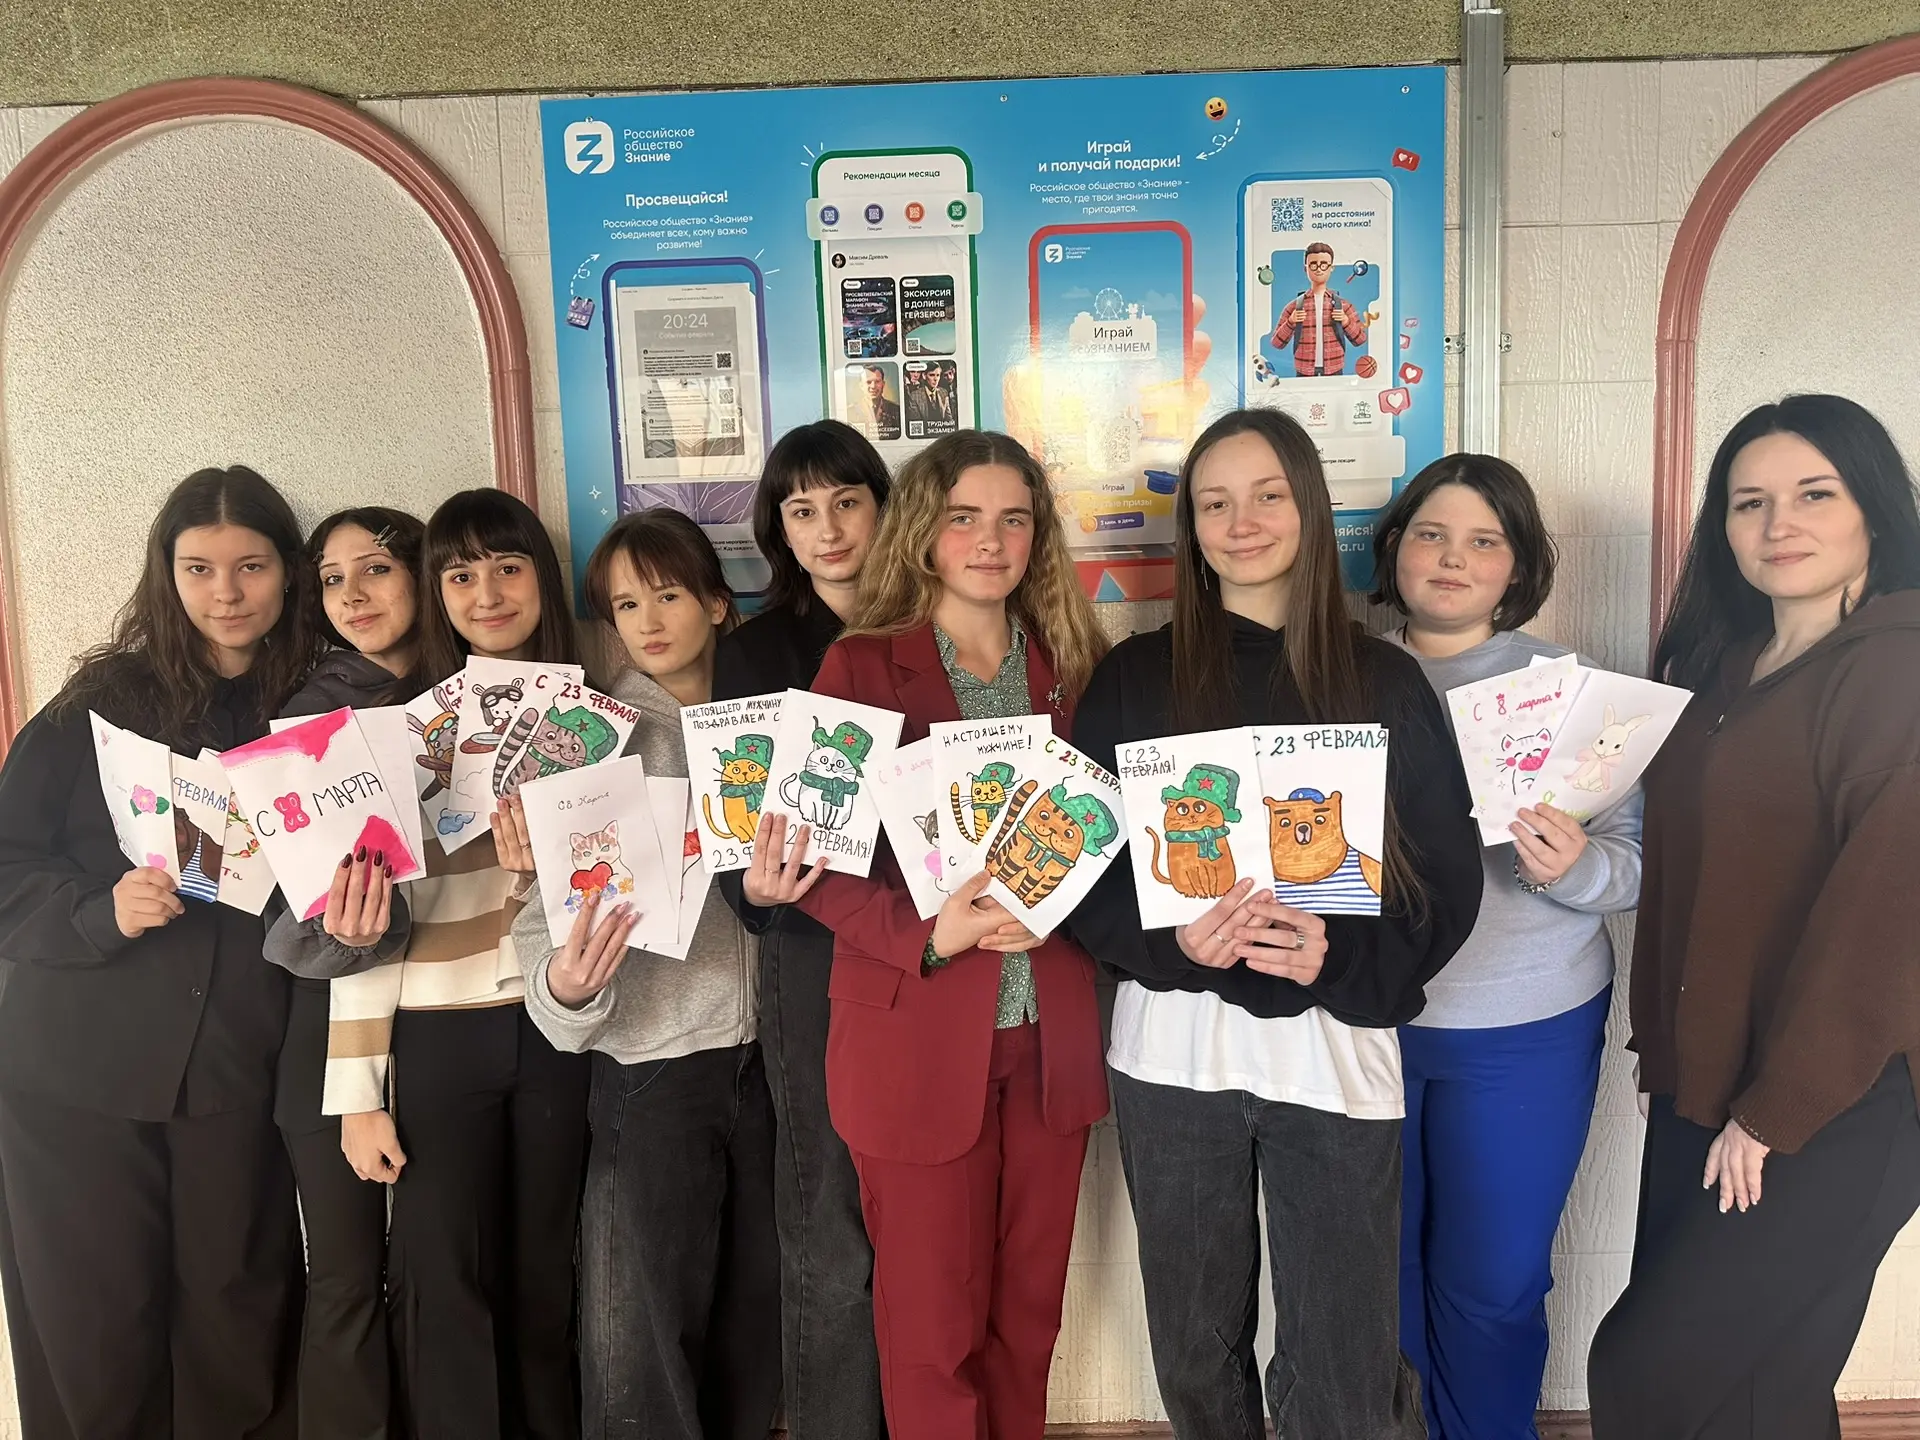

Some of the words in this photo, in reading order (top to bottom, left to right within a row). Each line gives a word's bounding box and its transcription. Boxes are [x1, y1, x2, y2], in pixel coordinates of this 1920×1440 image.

[624, 128, 695, 140] Российское
[624, 141, 683, 151] общество
[1087, 140, 1131, 156] Играй
[625, 152, 671, 163] Знание
[1038, 163, 1047, 172] и
[1051, 158, 1111, 174] получай
[1115, 155, 1181, 171] подарки!
[843, 172, 906, 181] Рекомендации
[909, 170, 941, 179] месяца
[1029, 182, 1086, 192] Российское
[1088, 181, 1135, 191] общество
[1137, 179, 1182, 188] «Знание»
[625, 190, 728, 209] Просвещайся!
[1042, 195, 1073, 204] место,
[1074, 195, 1090, 204] где
[1091, 194, 1113, 202] твои
[1115, 193, 1148, 201] знания
[1311, 200, 1342, 208] Знания
[1082, 204, 1138, 215] пригодятся.
[1325, 210, 1375, 220] расстоянии
[603, 217, 658, 228] Российское
[660, 216, 707, 226] общество
[709, 215, 753, 224] «Знание»
[1311, 221, 1341, 229] одного
[1343, 220, 1371, 228] клика!
[611, 230, 665, 239] объединяет
[667, 229, 691, 238] всех,
[693, 228, 715, 238] кому
[717, 227, 748, 236] важно
[656, 239, 703, 251] развитие!
[903, 289, 951, 298] ЭКСКУРСИЯ
[911, 300, 945, 309] ДОЛИНЕ
[663, 313, 708, 329] 20:24
[904, 310, 945, 319] ГЕЙЗЕРОВ
[1093, 326, 1133, 340] Играй
[1102, 484, 1125, 492] Играй
[1123, 499, 1152, 508] призы
[1336, 540, 1365, 552] ia.ru
[535, 674, 548, 689] С
[560, 682, 581, 700] 23
[588, 693, 640, 724] ФЕВРАЛЯ
[685, 702, 741, 719] НАСТОЯЩЕГО
[745, 698, 782, 711] МУЖЧИНУ
[1473, 702, 1482, 721] С
[1496, 693, 1507, 715] 8
[693, 713, 766, 730] ПОЗДРАВЛЯЕМ
[773, 712, 780, 722] С
[943, 724, 1024, 747] НАСТОЯЩЕМУ
[1270, 736, 1295, 756] 23
[1303, 729, 1388, 749] ФЕВРАЛЯ
[976, 734, 1032, 755] МУЖЧИНЕ!
[1045, 739, 1057, 753] С
[1058, 750, 1078, 766] 23
[1136, 745, 1161, 763] 23
[1120, 755, 1176, 779] ФЕВРАЛЯ!
[172, 776, 228, 812] ФЕВРАЛЯ
[312, 771, 383, 816] МАРТА
[256, 810, 276, 837] С
[813, 830, 873, 859] ФЕВРАЛЯ!
[712, 848, 739, 868] 23
